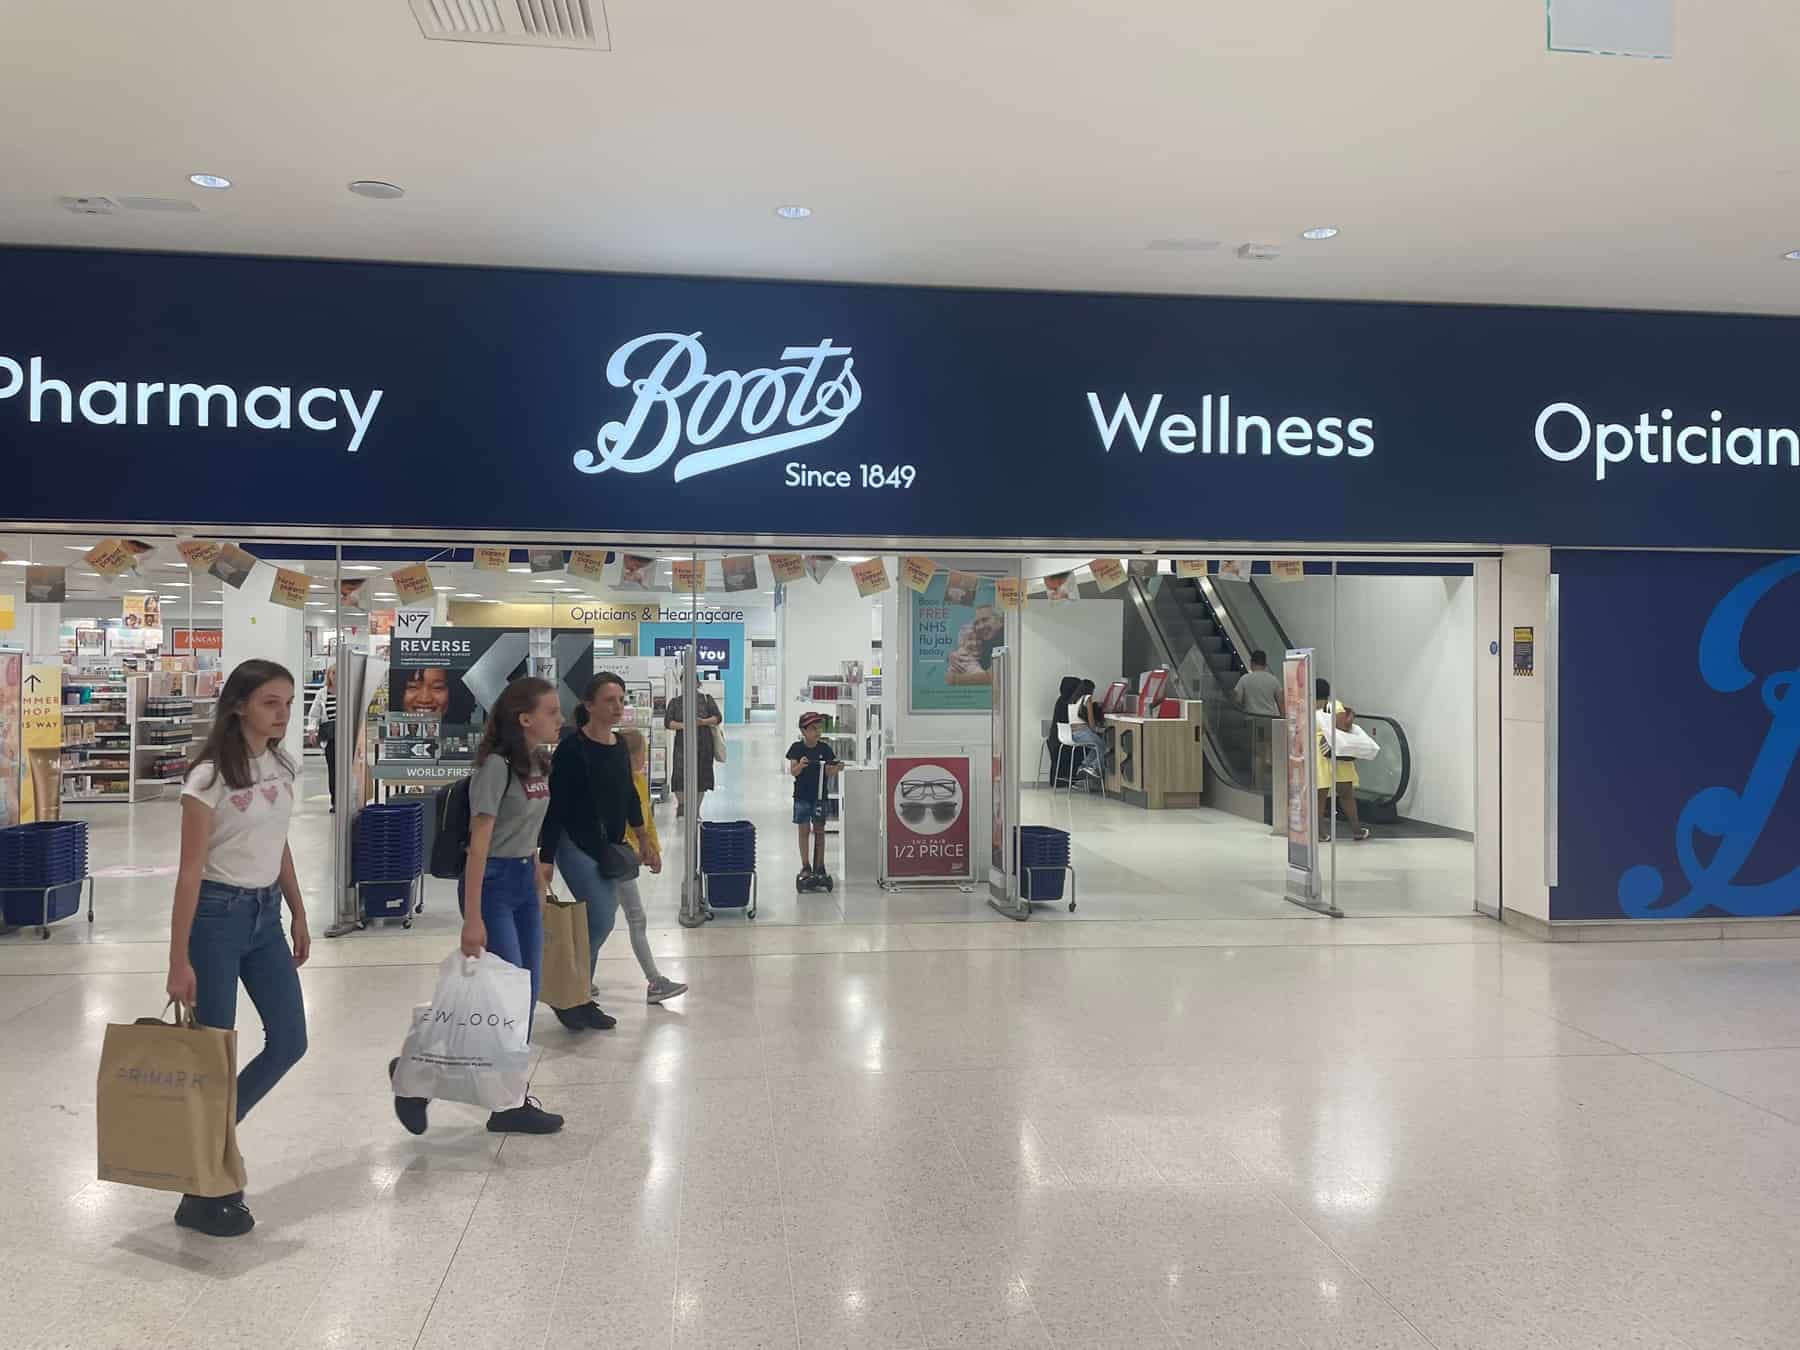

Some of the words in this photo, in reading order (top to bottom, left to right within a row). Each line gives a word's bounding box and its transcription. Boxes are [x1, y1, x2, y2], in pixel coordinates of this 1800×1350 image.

[0, 356, 384, 452] Pharmacy
[574, 332, 861, 482] Boots
[1087, 392, 1375, 457] Wellness
[1535, 402, 1800, 481] Optician
[785, 463, 852, 488] Since
[860, 464, 916, 489] 1849
[571, 607, 637, 624] Opticians
[641, 608, 652, 621] &
[658, 607, 744, 624] Hearngcare
[919, 607, 951, 619] FREE
[919, 622, 947, 633] NHS
[400, 640, 472, 652] REVERSE
[933, 632, 953, 648] jab
[699, 650, 726, 661] YOU
[22, 697, 59, 705] MMER
[22, 708, 51, 716] HOP
[407, 767, 446, 777] WORLD
[893, 844, 915, 859] 1/2
[919, 843, 964, 858] PRICE
[422, 1007, 455, 1024] EW
